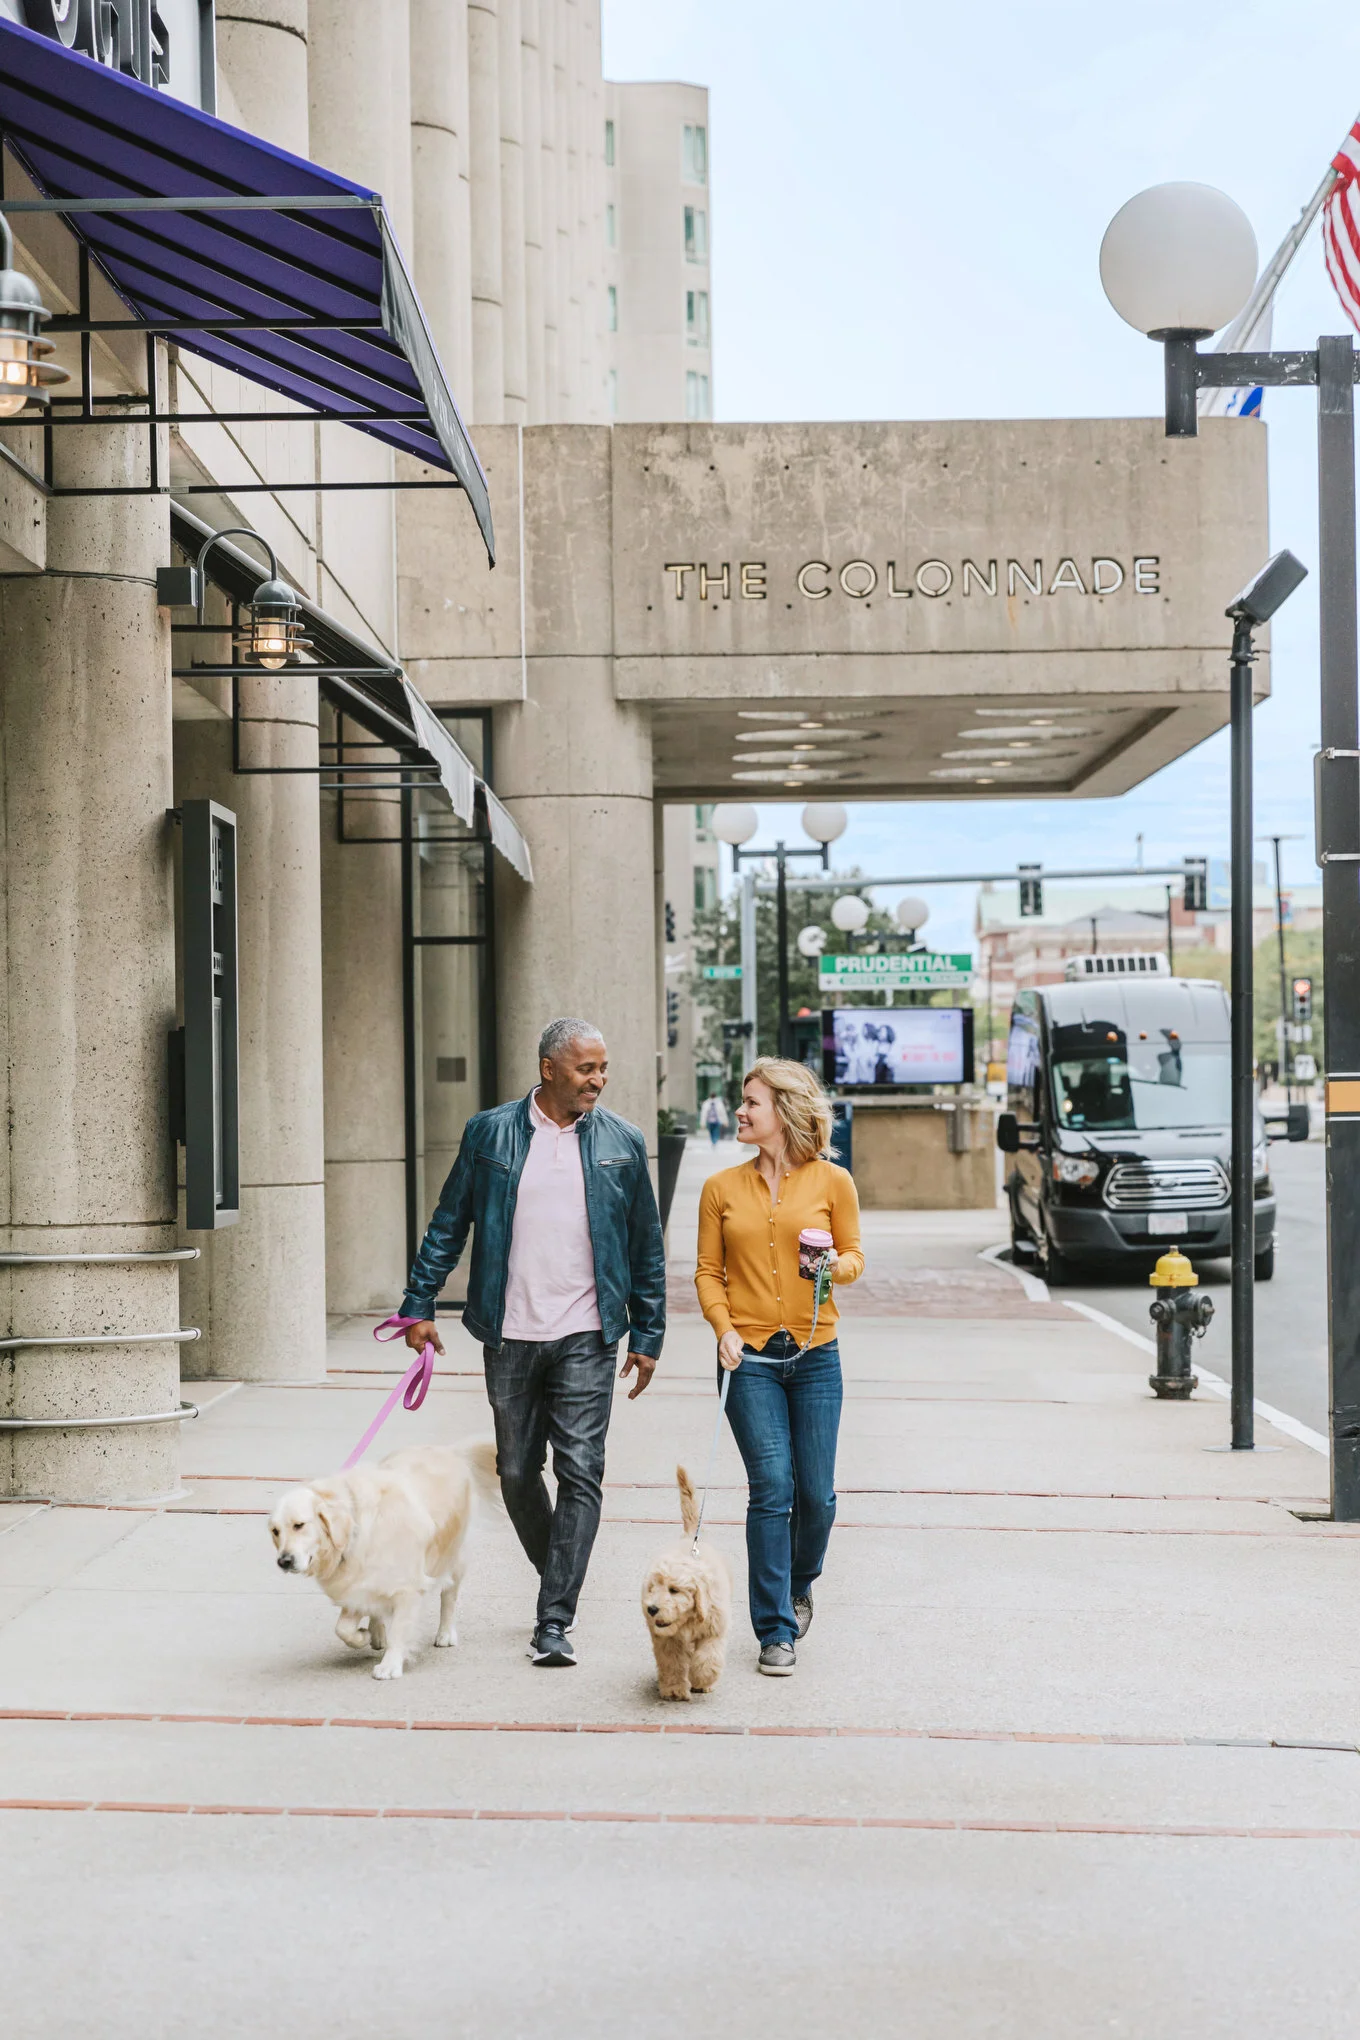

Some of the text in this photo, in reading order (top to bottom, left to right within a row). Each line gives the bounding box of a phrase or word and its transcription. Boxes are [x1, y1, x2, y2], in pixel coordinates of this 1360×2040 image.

[664, 556, 1160, 600] THE COLONNADE
[834, 955, 958, 973] PRUDENTIAL
